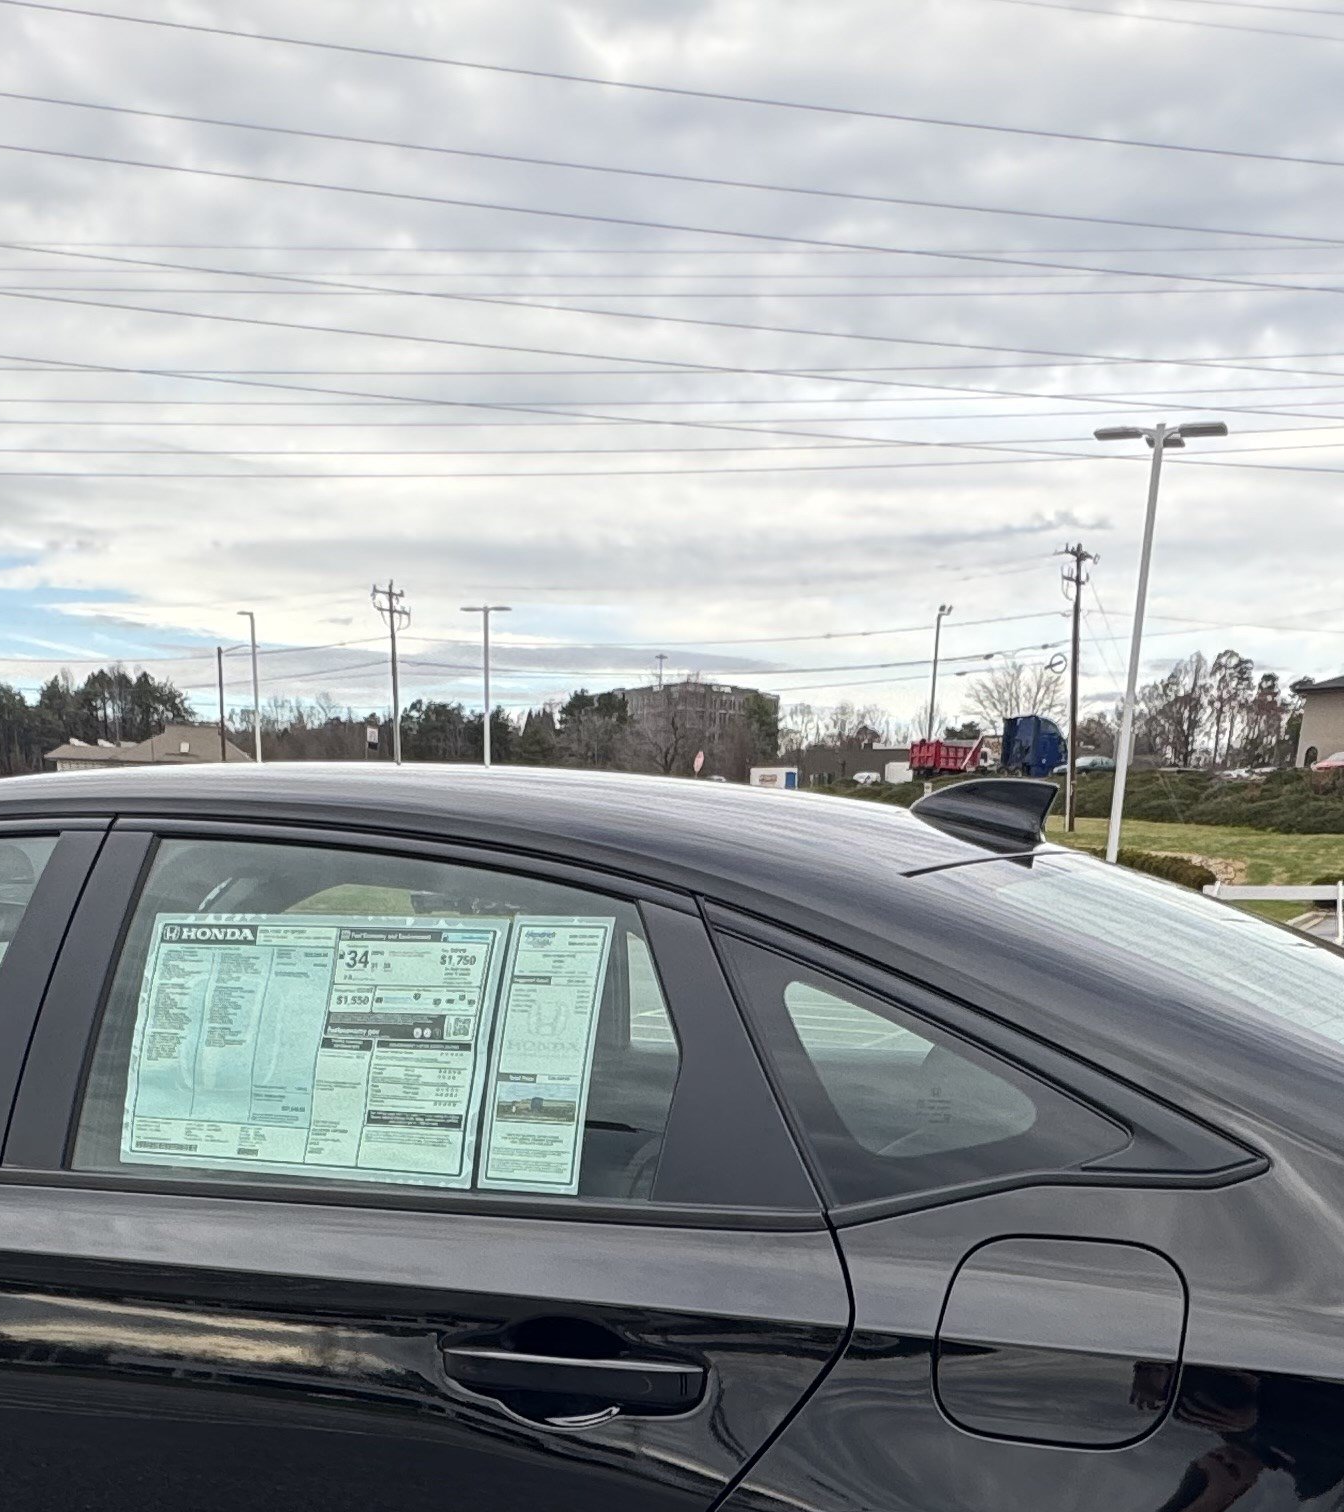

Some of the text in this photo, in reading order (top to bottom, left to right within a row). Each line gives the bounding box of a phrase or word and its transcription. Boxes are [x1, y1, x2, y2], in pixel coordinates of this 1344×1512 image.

[181, 927, 255, 941] HONDA
[345, 950, 369, 969] 34
[440, 953, 476, 966] $1,750
